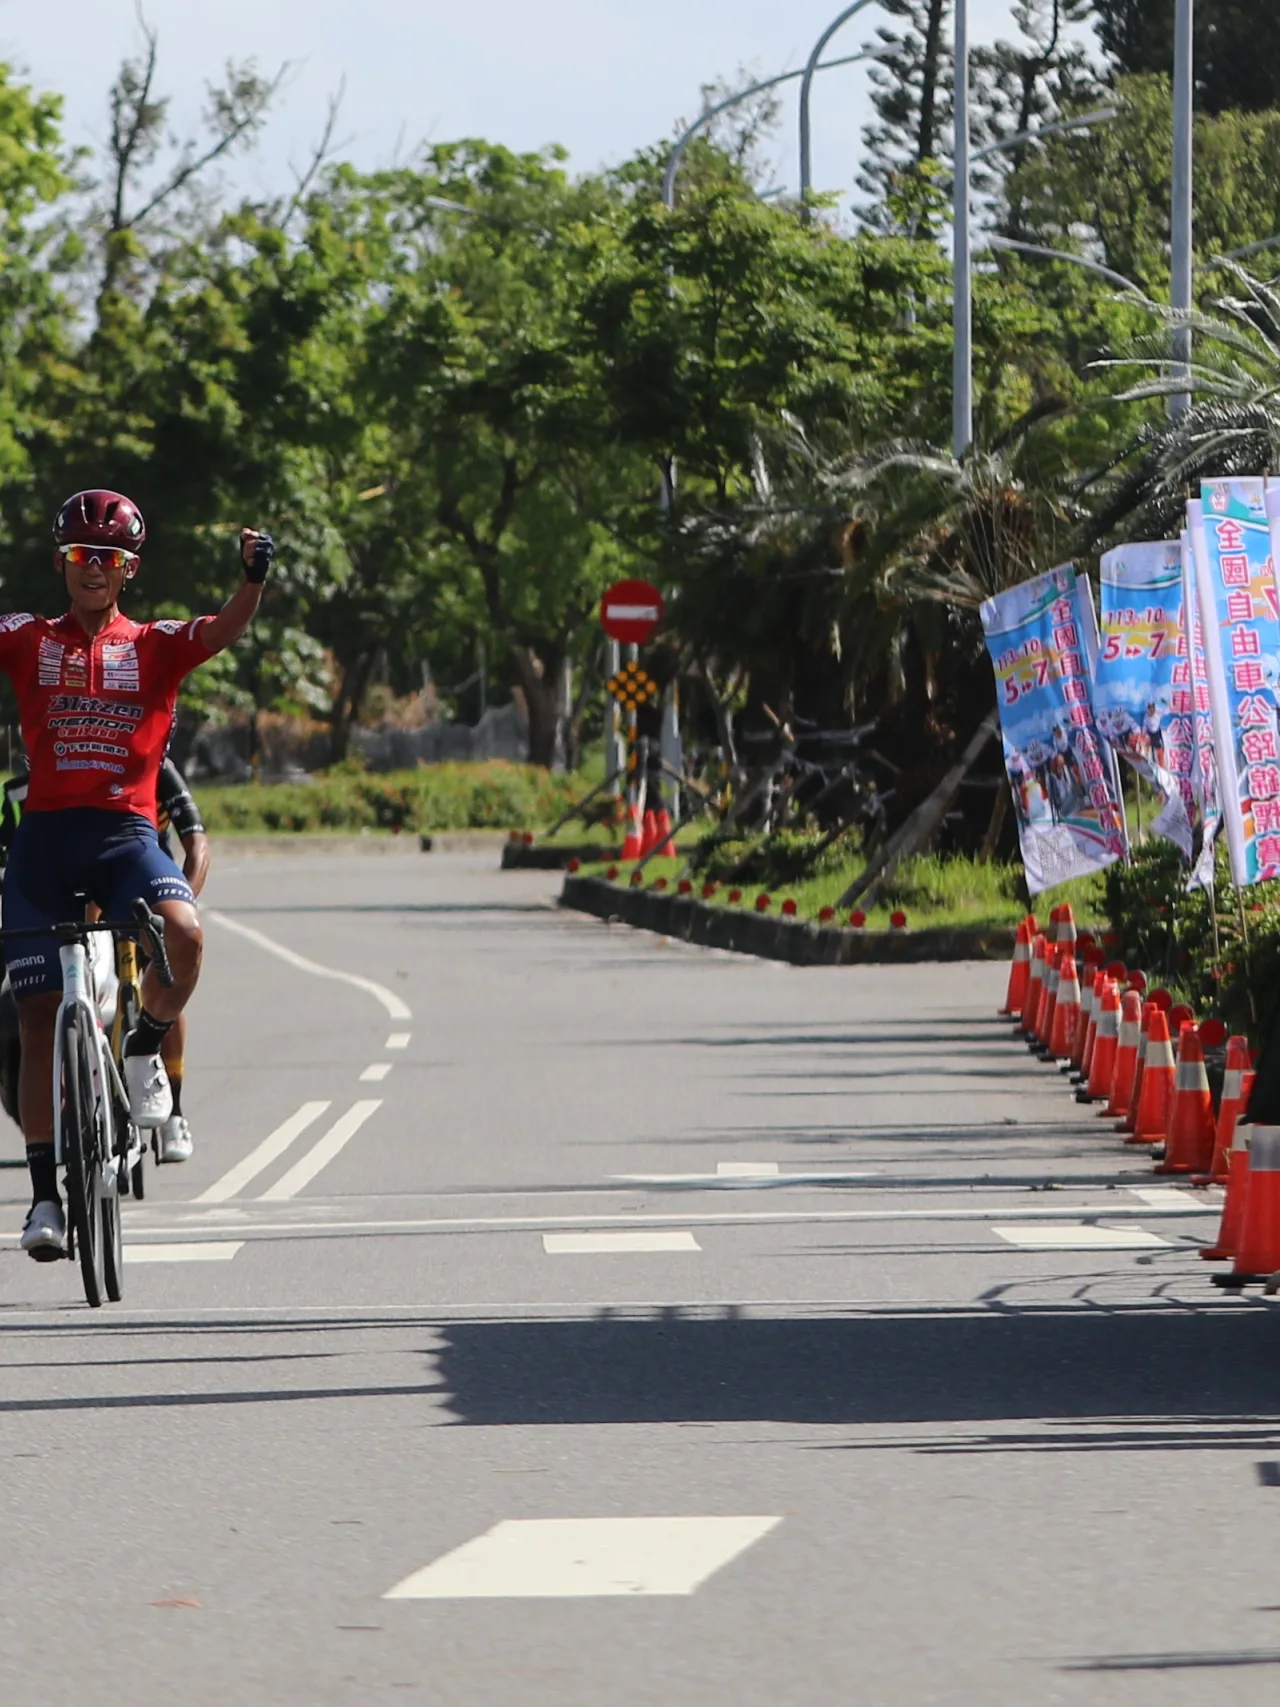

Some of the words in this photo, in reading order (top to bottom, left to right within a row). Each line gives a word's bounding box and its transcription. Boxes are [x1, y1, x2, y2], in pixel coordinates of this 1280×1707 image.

[1103, 635, 1122, 660] 5
[1004, 675, 1020, 704] 5
[48, 716, 136, 733] MERIDA
